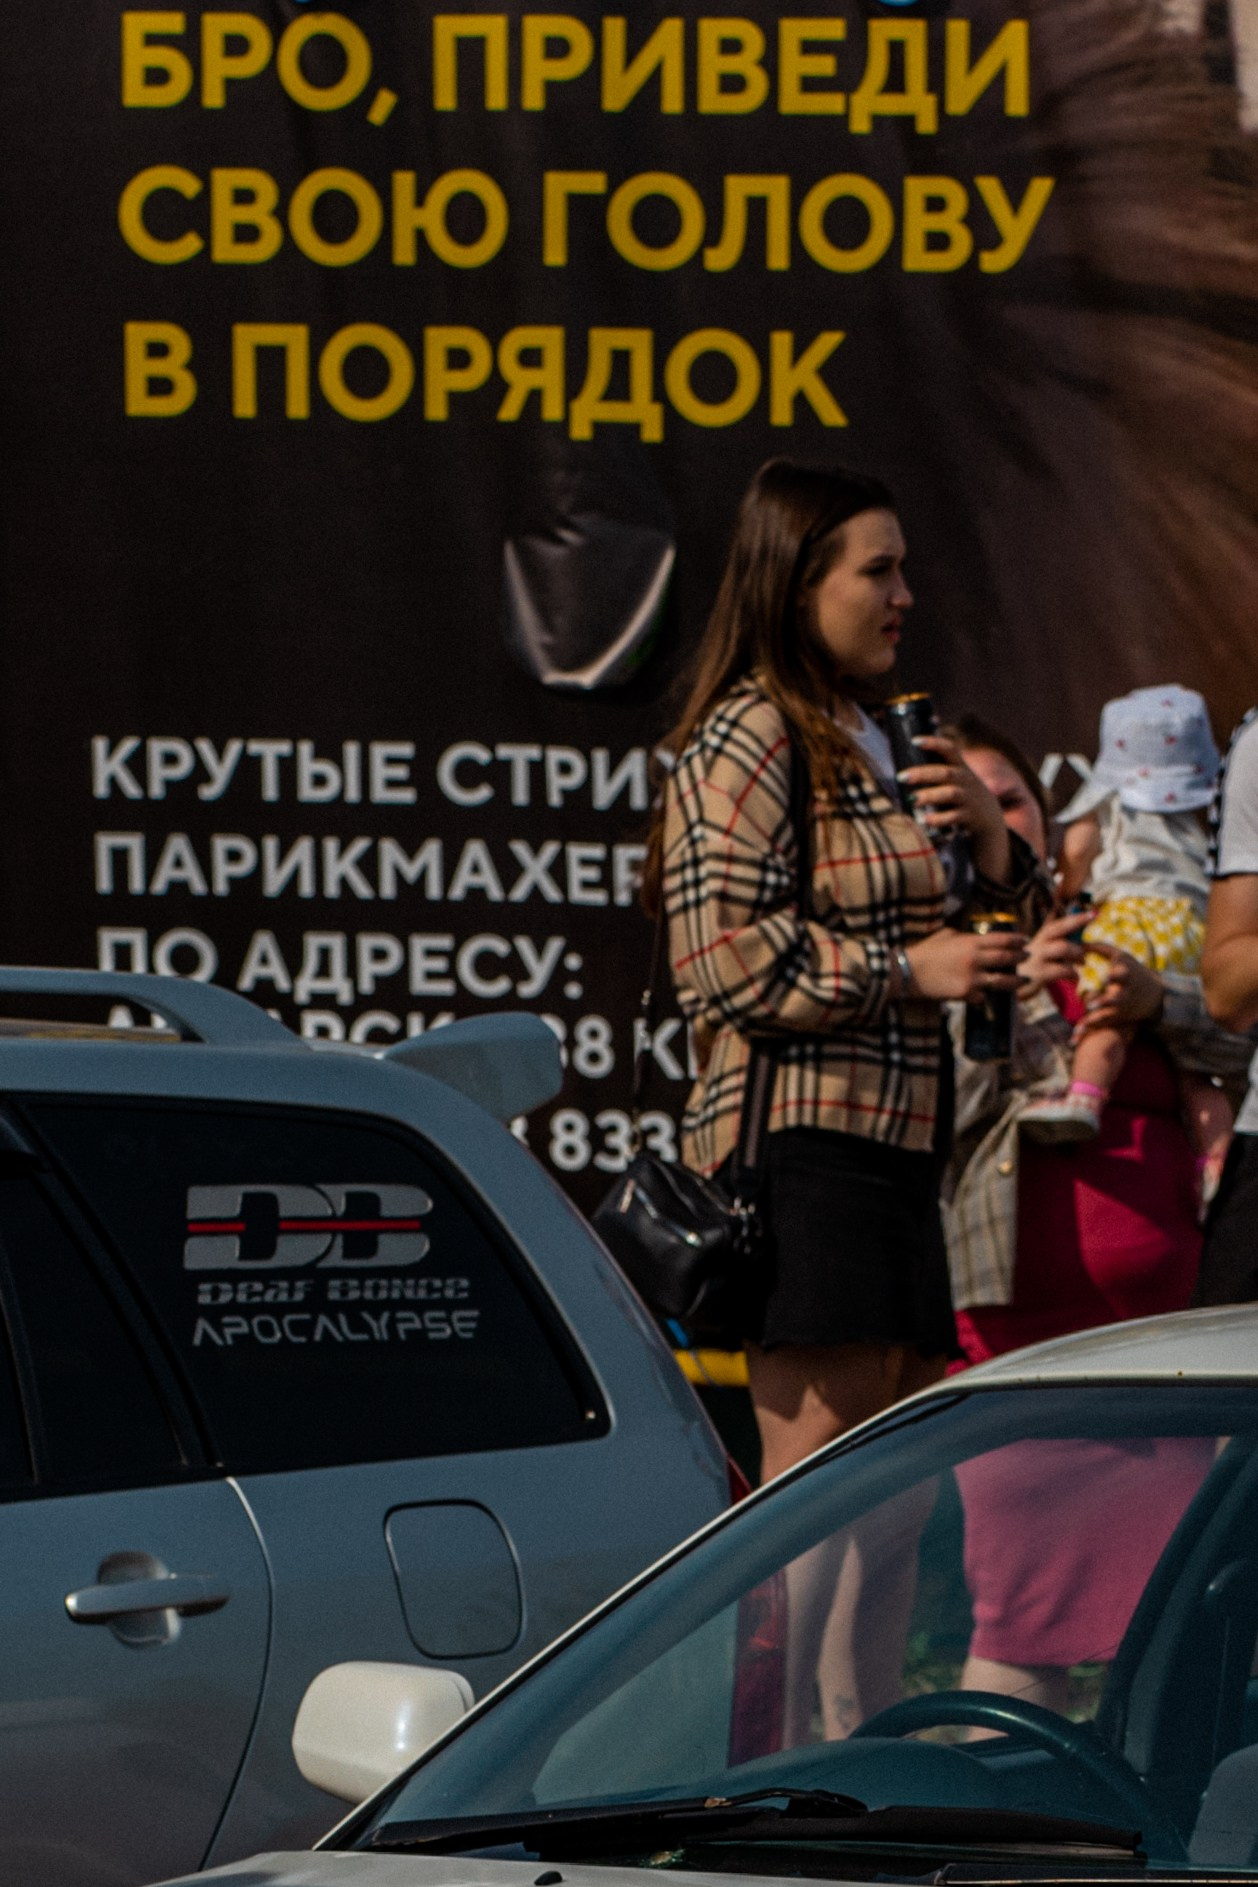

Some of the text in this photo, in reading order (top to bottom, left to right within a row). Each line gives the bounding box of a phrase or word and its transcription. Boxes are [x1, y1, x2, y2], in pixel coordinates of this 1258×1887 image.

[121, 11, 1030, 134] БРО, ПРИВЕДИ
[118, 165, 1056, 273] СВОЮ ГОЛОВУ
[124, 321, 848, 442] В ПОРЯДОК
[91, 736, 662, 811] КРУТЫЕ СТРИ
[97, 926, 584, 1005] ПО АДРЕСУ:
[193, 1310, 480, 1347] APOCALYPSE
